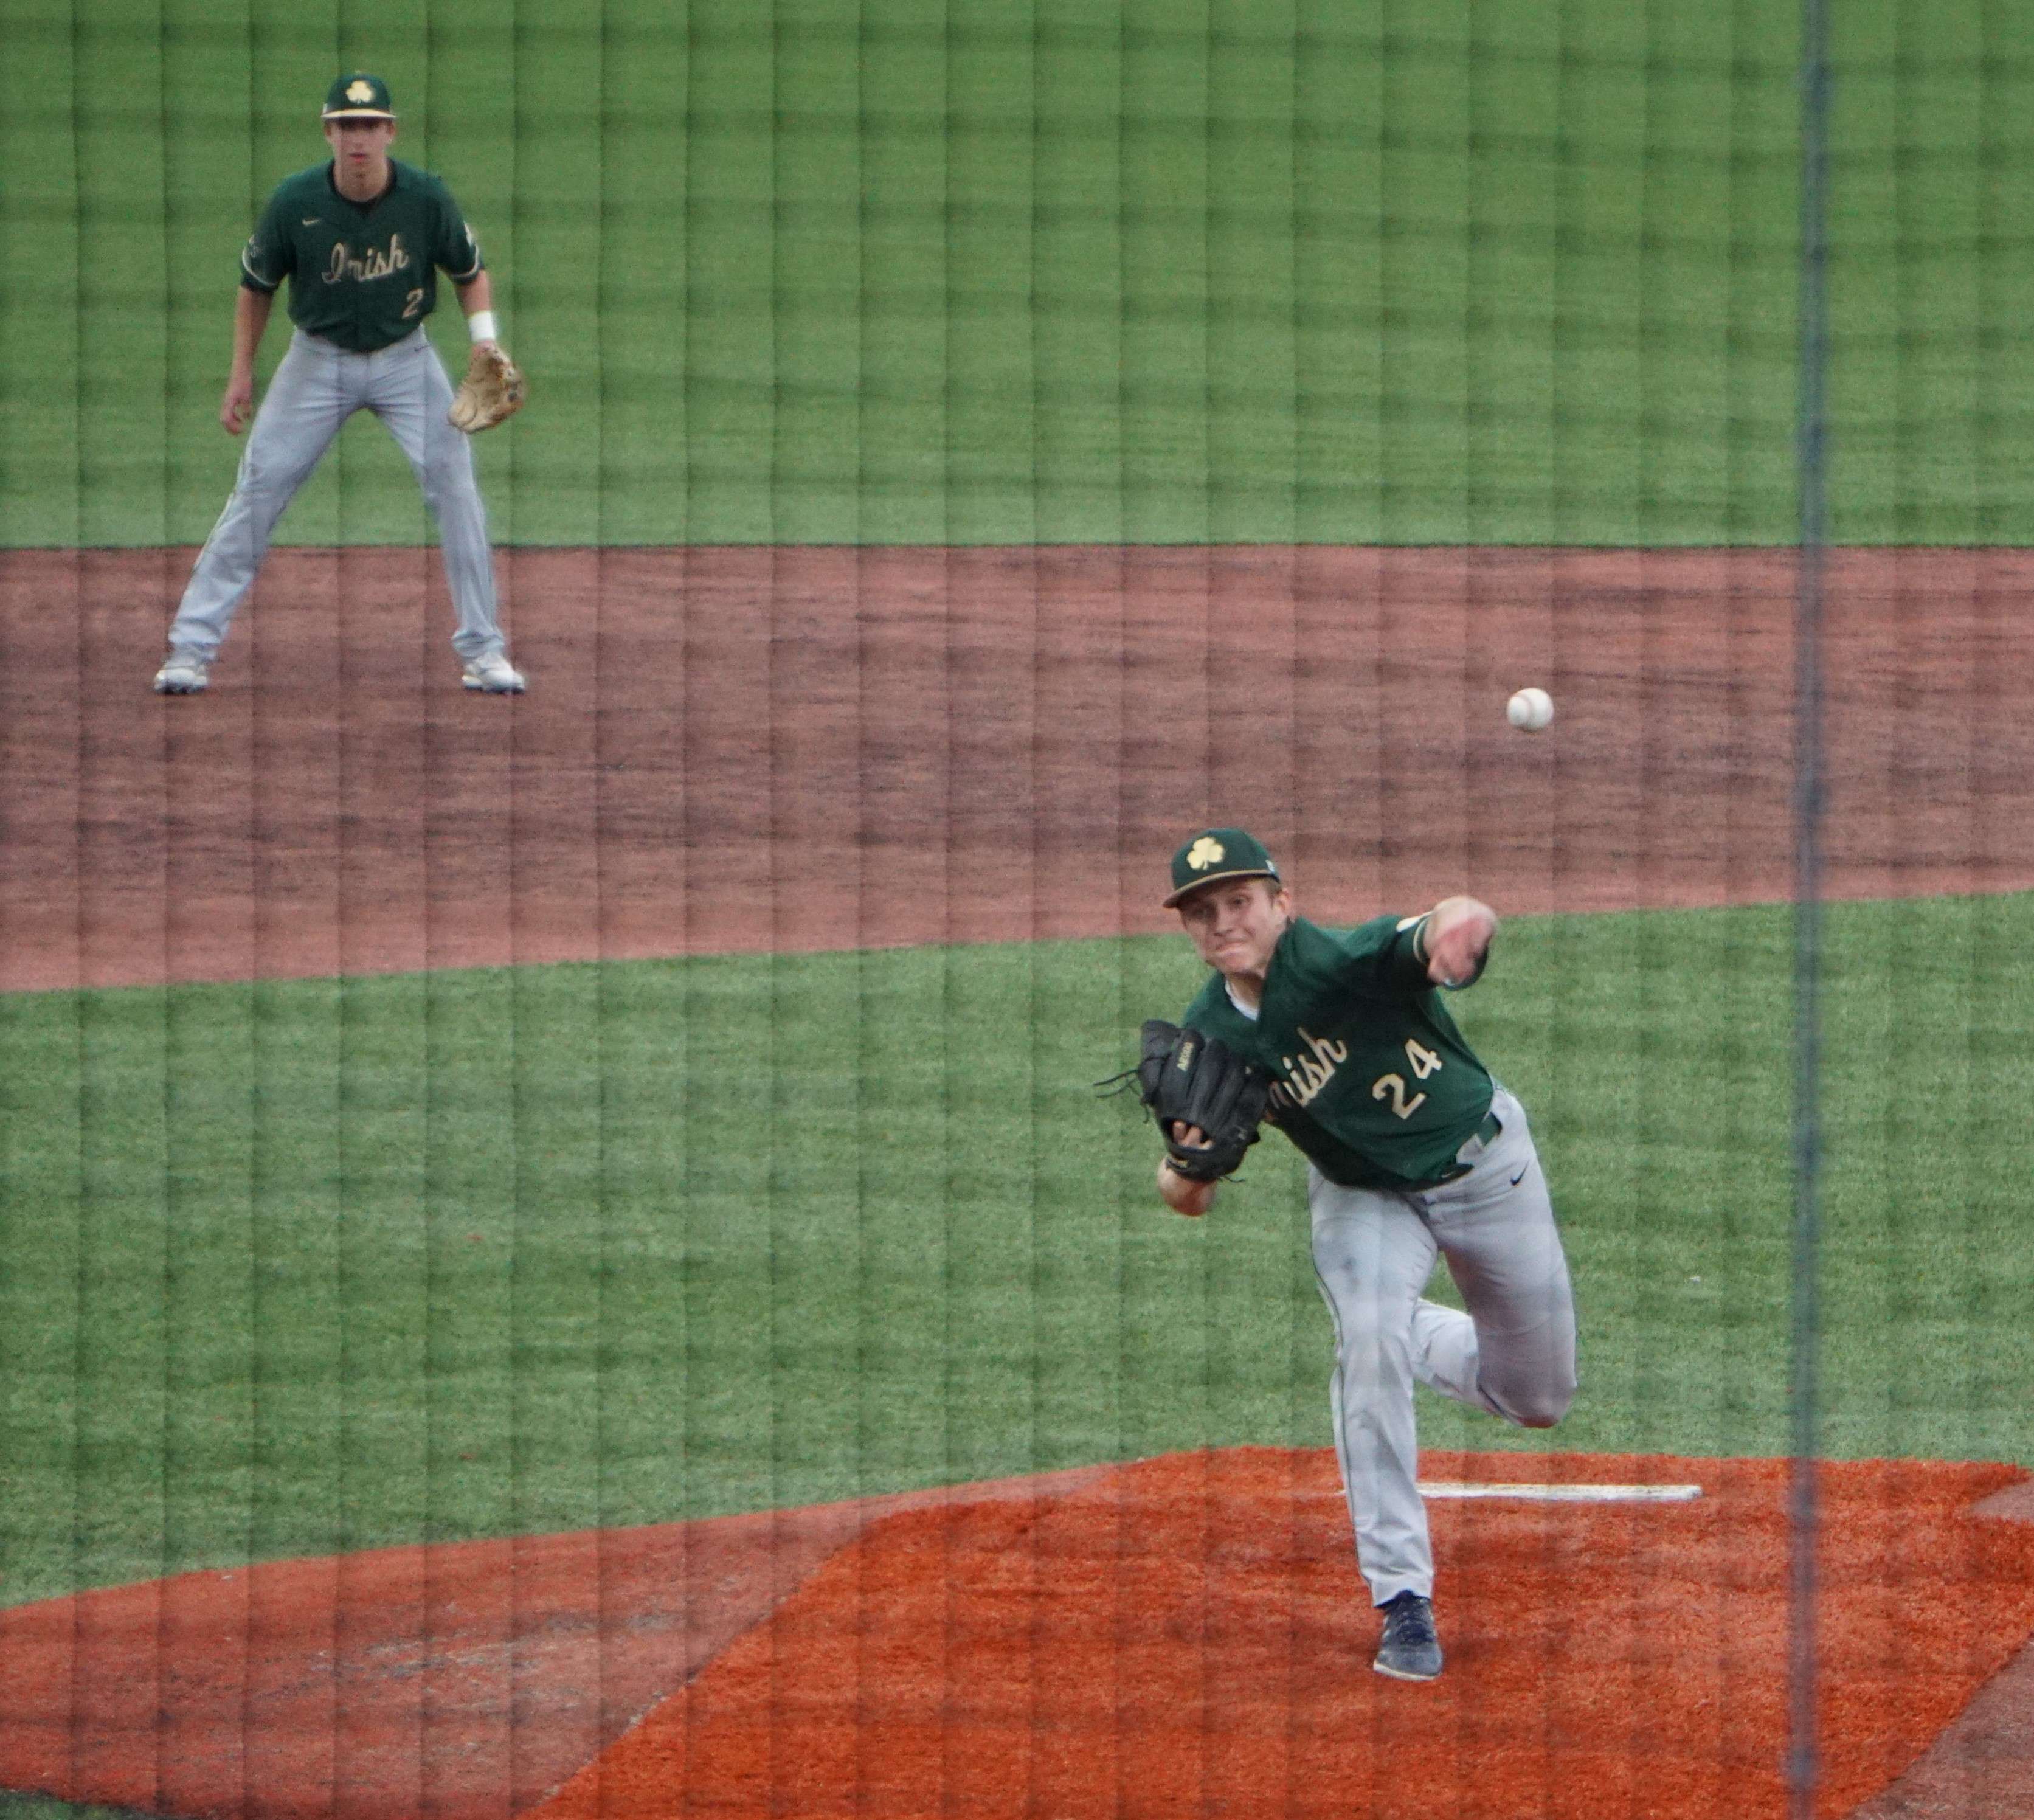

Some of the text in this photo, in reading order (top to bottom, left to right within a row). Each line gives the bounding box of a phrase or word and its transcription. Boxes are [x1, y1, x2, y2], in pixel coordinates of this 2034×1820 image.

[321, 233, 409, 285] Irish
[401, 288, 424, 320] 2
[1268, 1026, 1348, 1109] rish
[1371, 1037, 1443, 1120] 24
